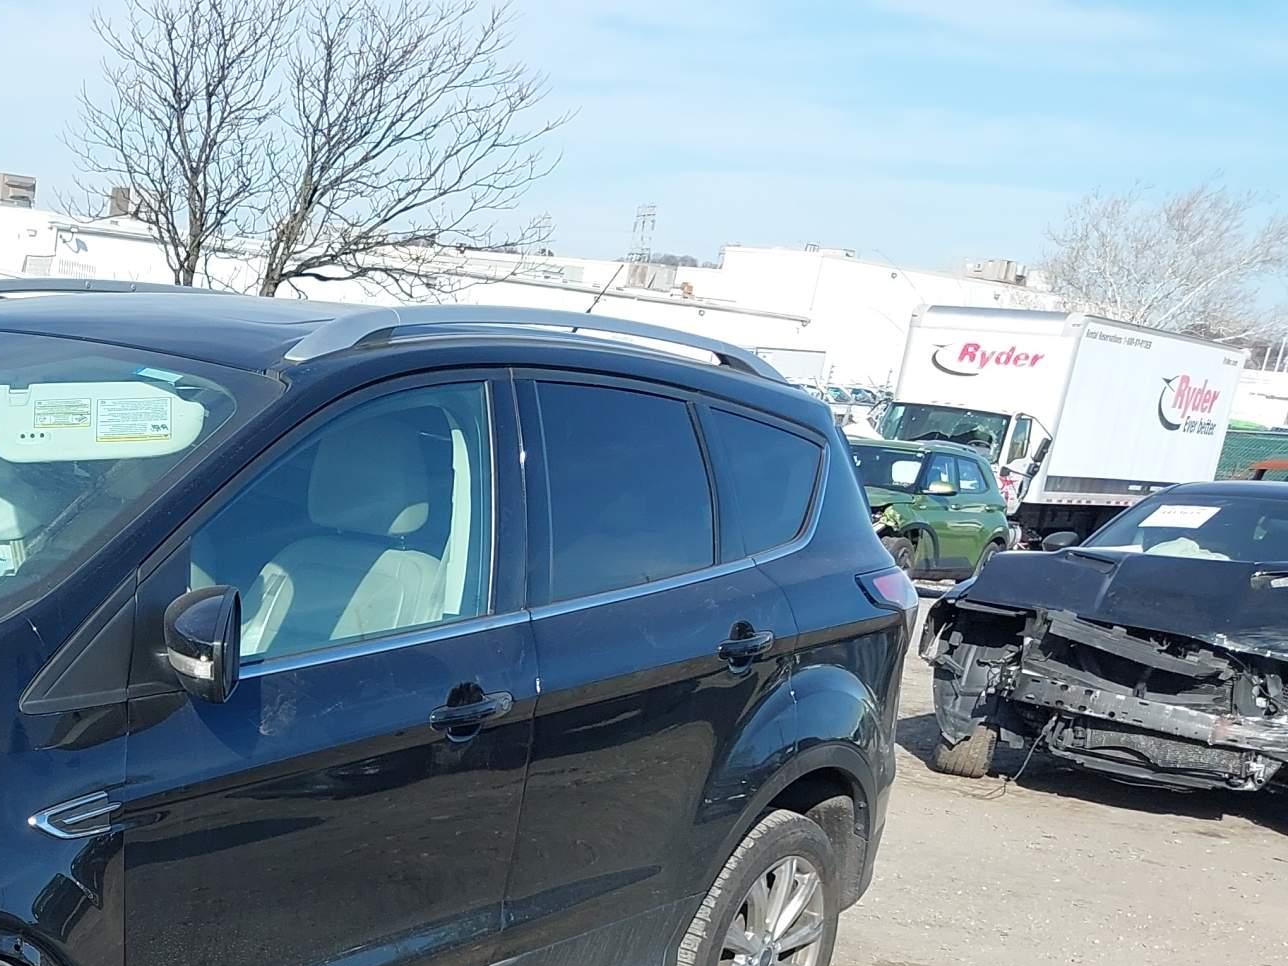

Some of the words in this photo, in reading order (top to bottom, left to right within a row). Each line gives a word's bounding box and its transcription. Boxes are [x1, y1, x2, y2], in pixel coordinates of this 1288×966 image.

[958, 342, 1045, 369] Ryder
[1172, 374, 1221, 418] Ryder
[1183, 416, 1198, 434] Ever
